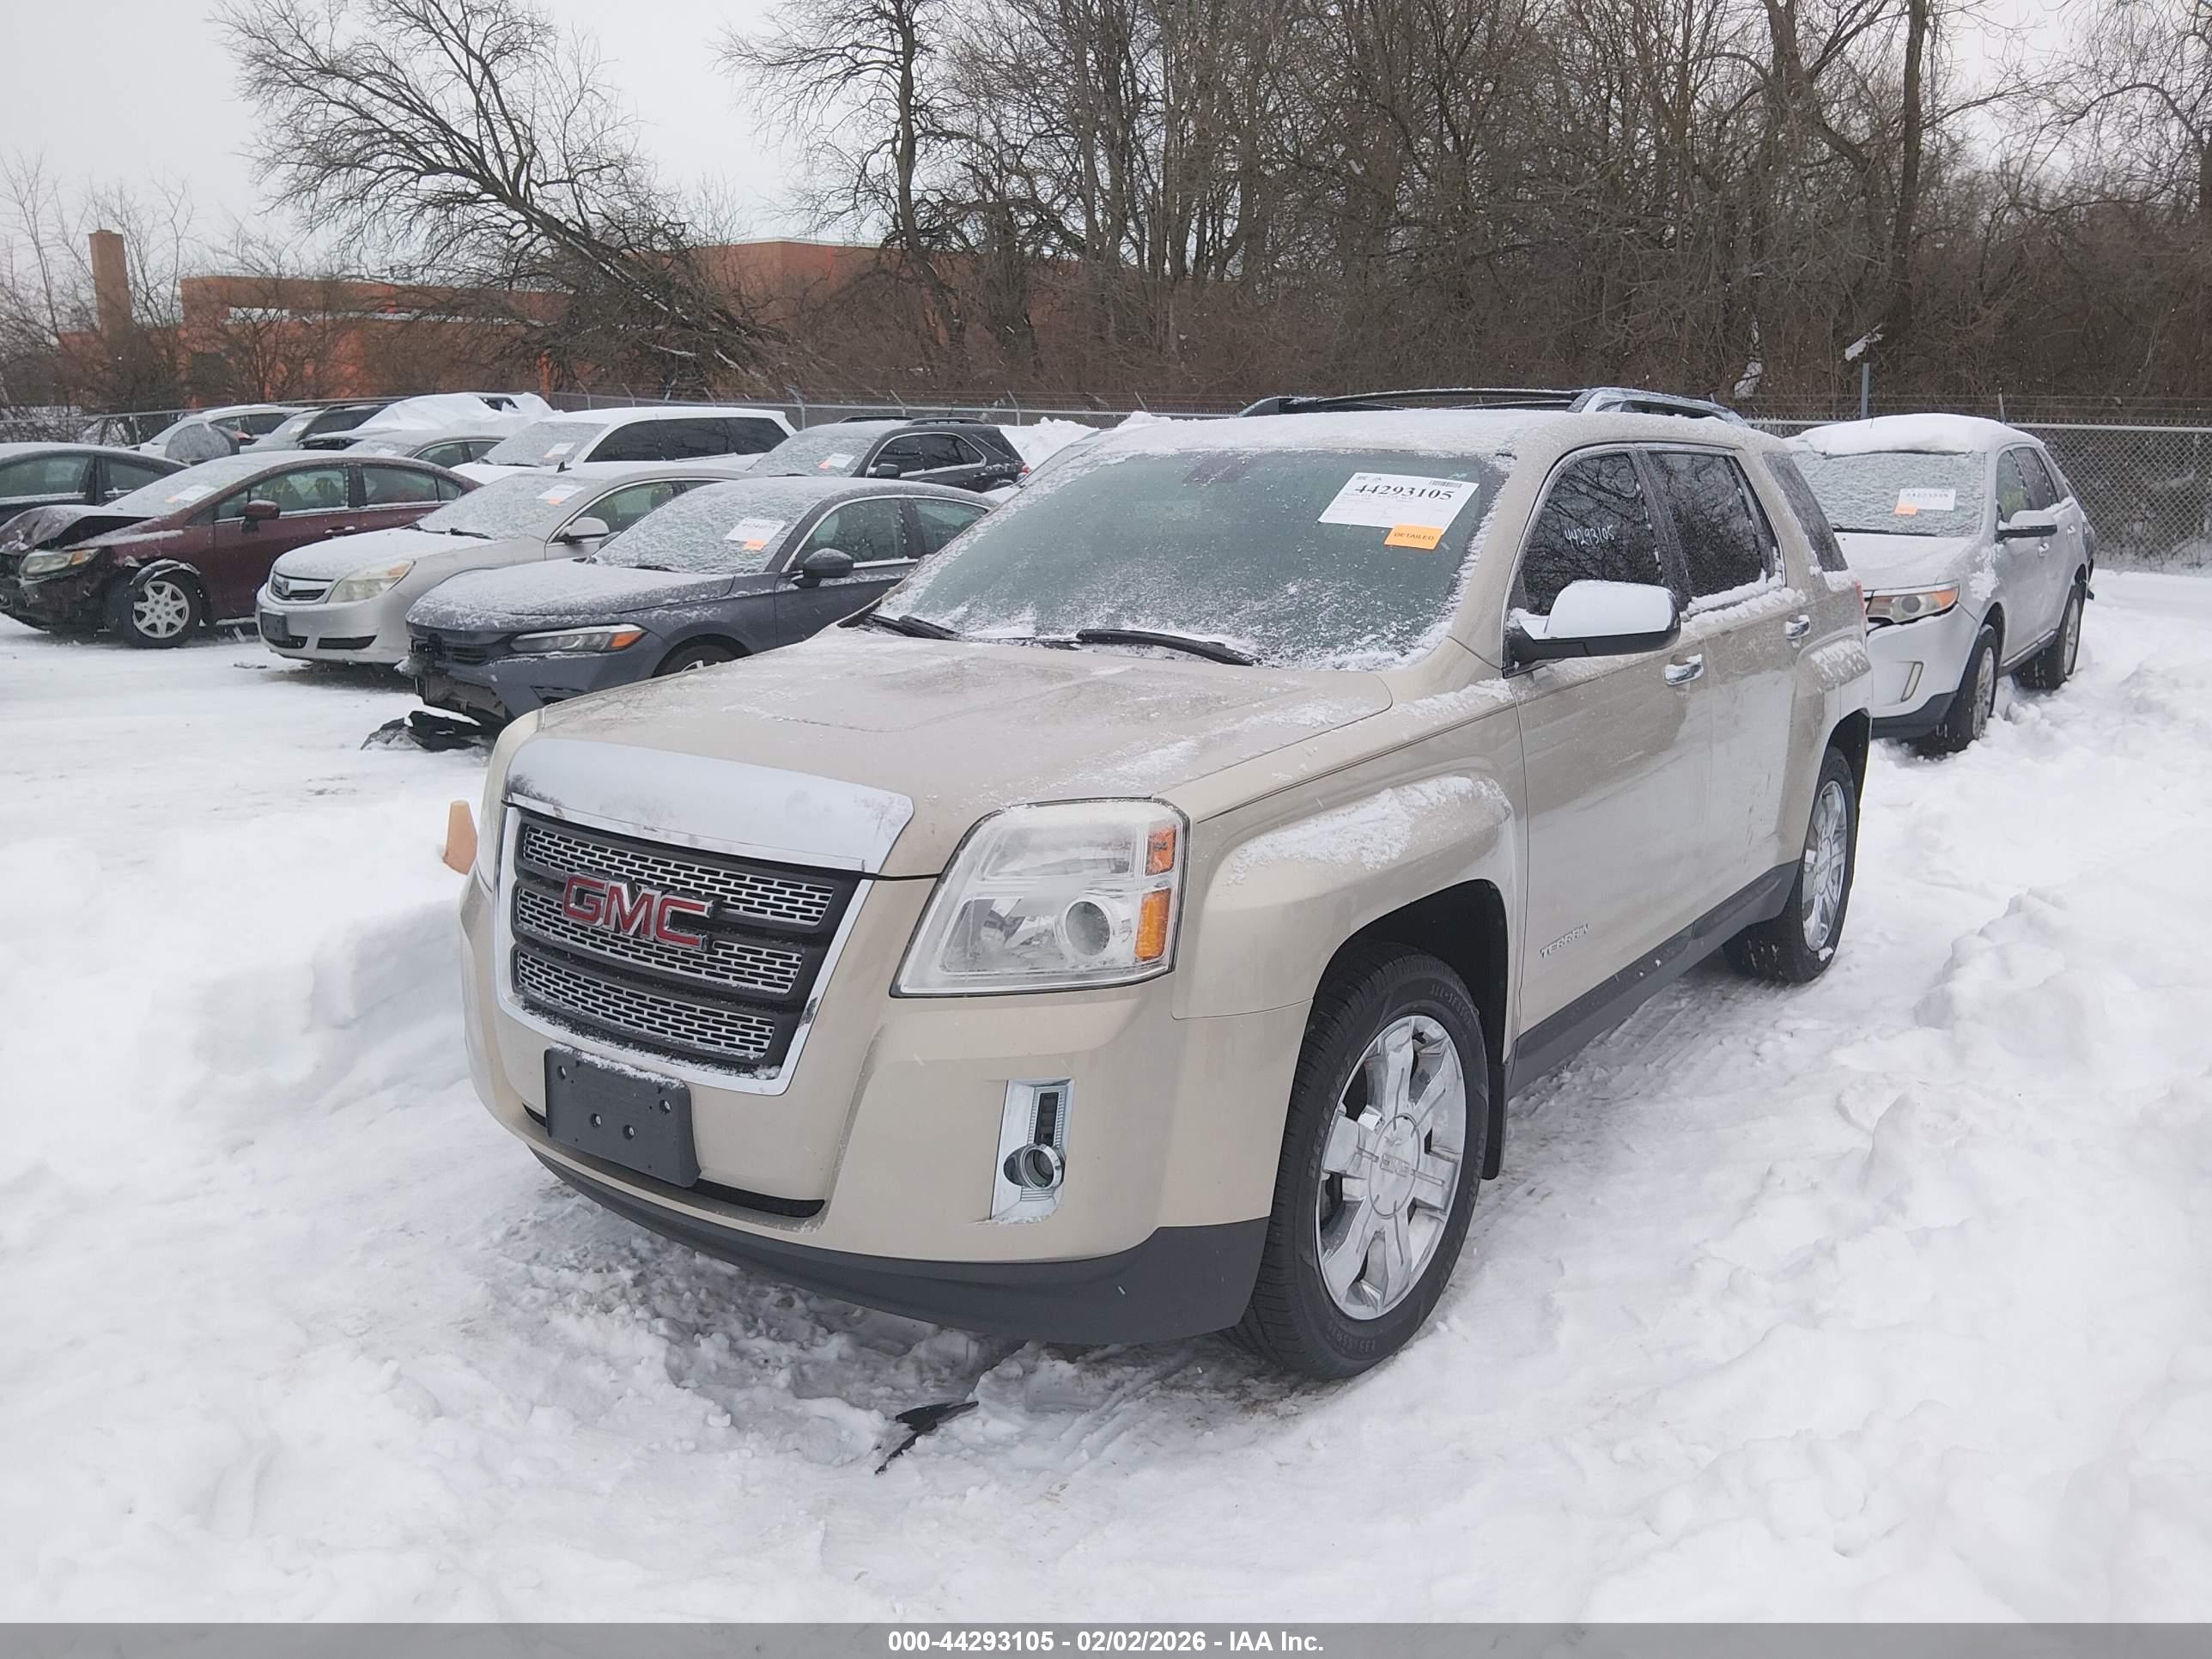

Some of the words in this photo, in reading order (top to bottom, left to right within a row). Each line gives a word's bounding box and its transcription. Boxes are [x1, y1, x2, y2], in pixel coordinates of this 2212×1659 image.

[1355, 484, 1455, 500] 44293105
[1394, 532, 1434, 541] DETAILED
[562, 871, 713, 951] GMC
[1540, 923, 1589, 958] TERRAIN
